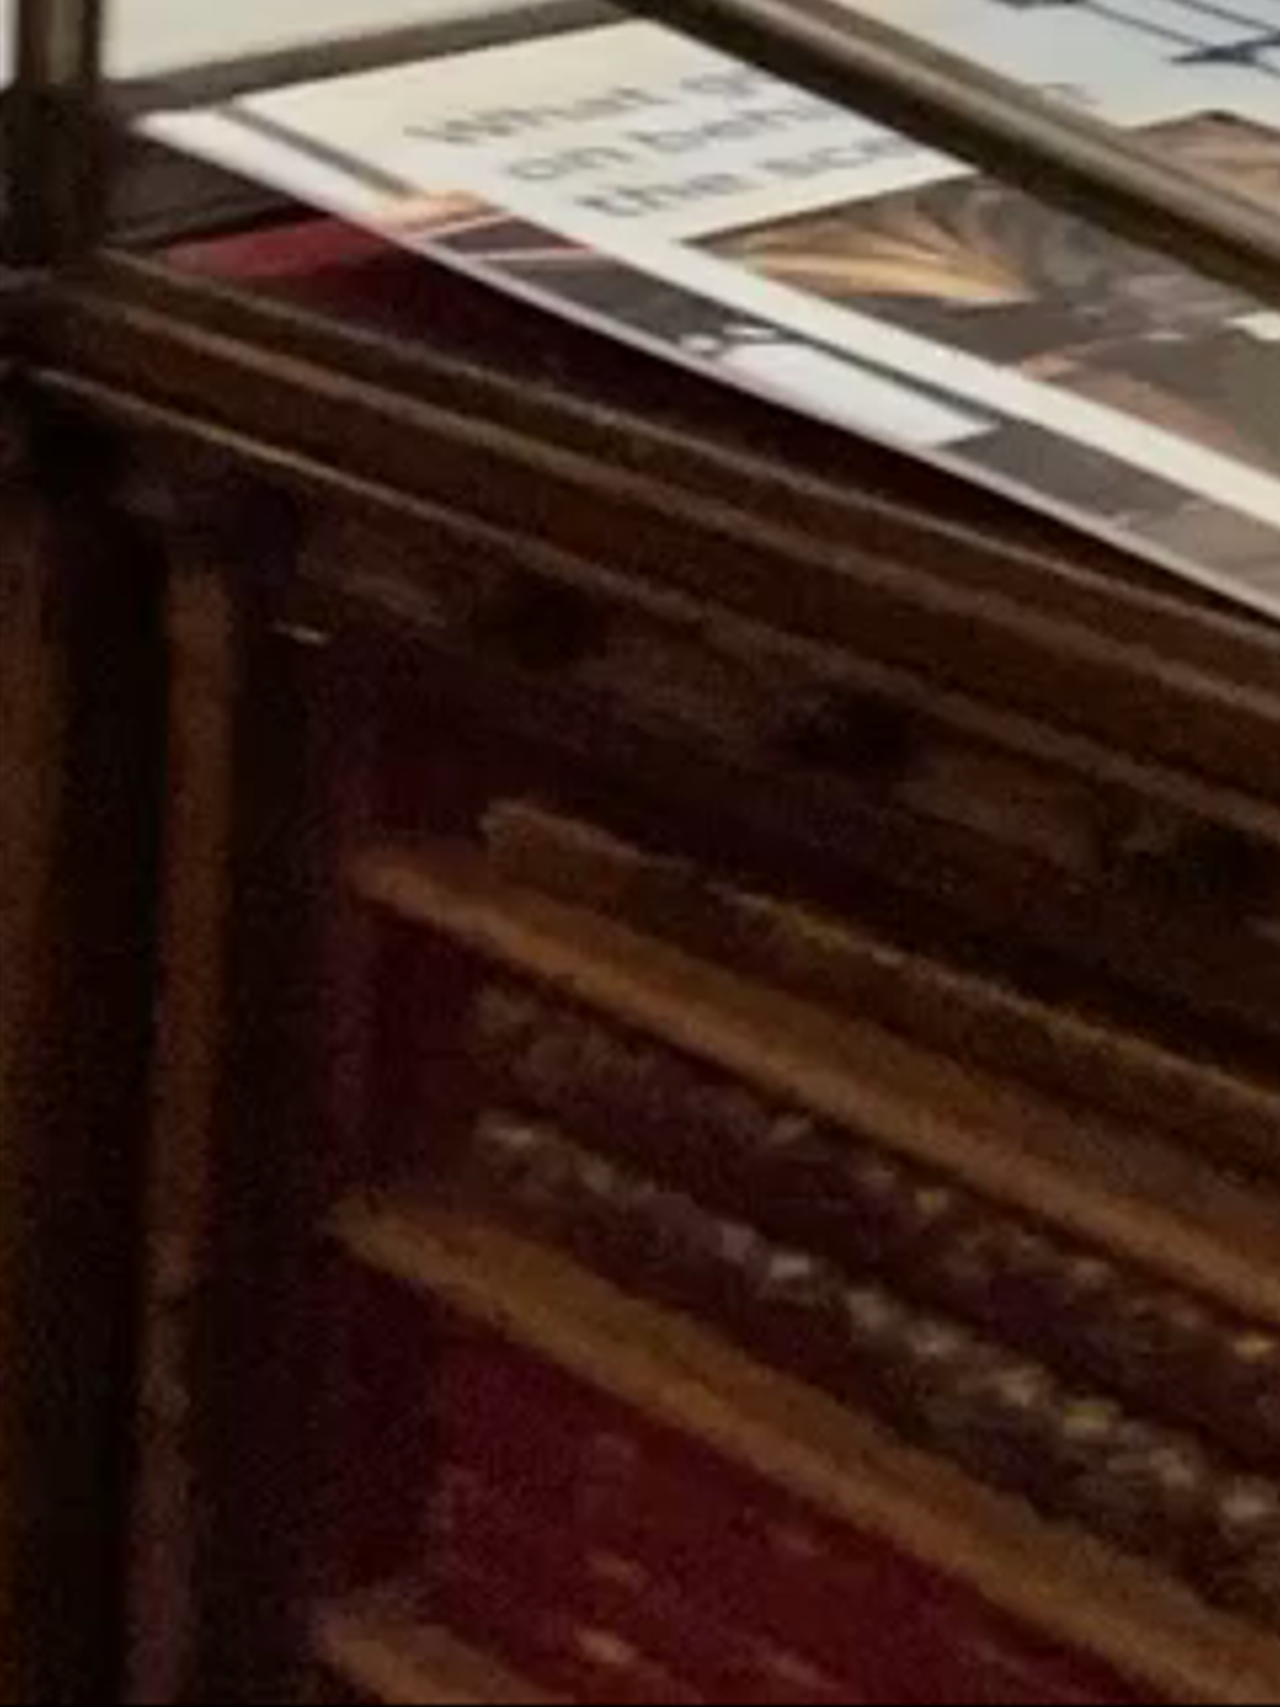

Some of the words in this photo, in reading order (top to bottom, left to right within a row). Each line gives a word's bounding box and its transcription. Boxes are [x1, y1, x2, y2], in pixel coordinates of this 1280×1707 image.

[402, 86, 672, 144] What
[508, 145, 638, 181] on
[572, 173, 750, 218] the
